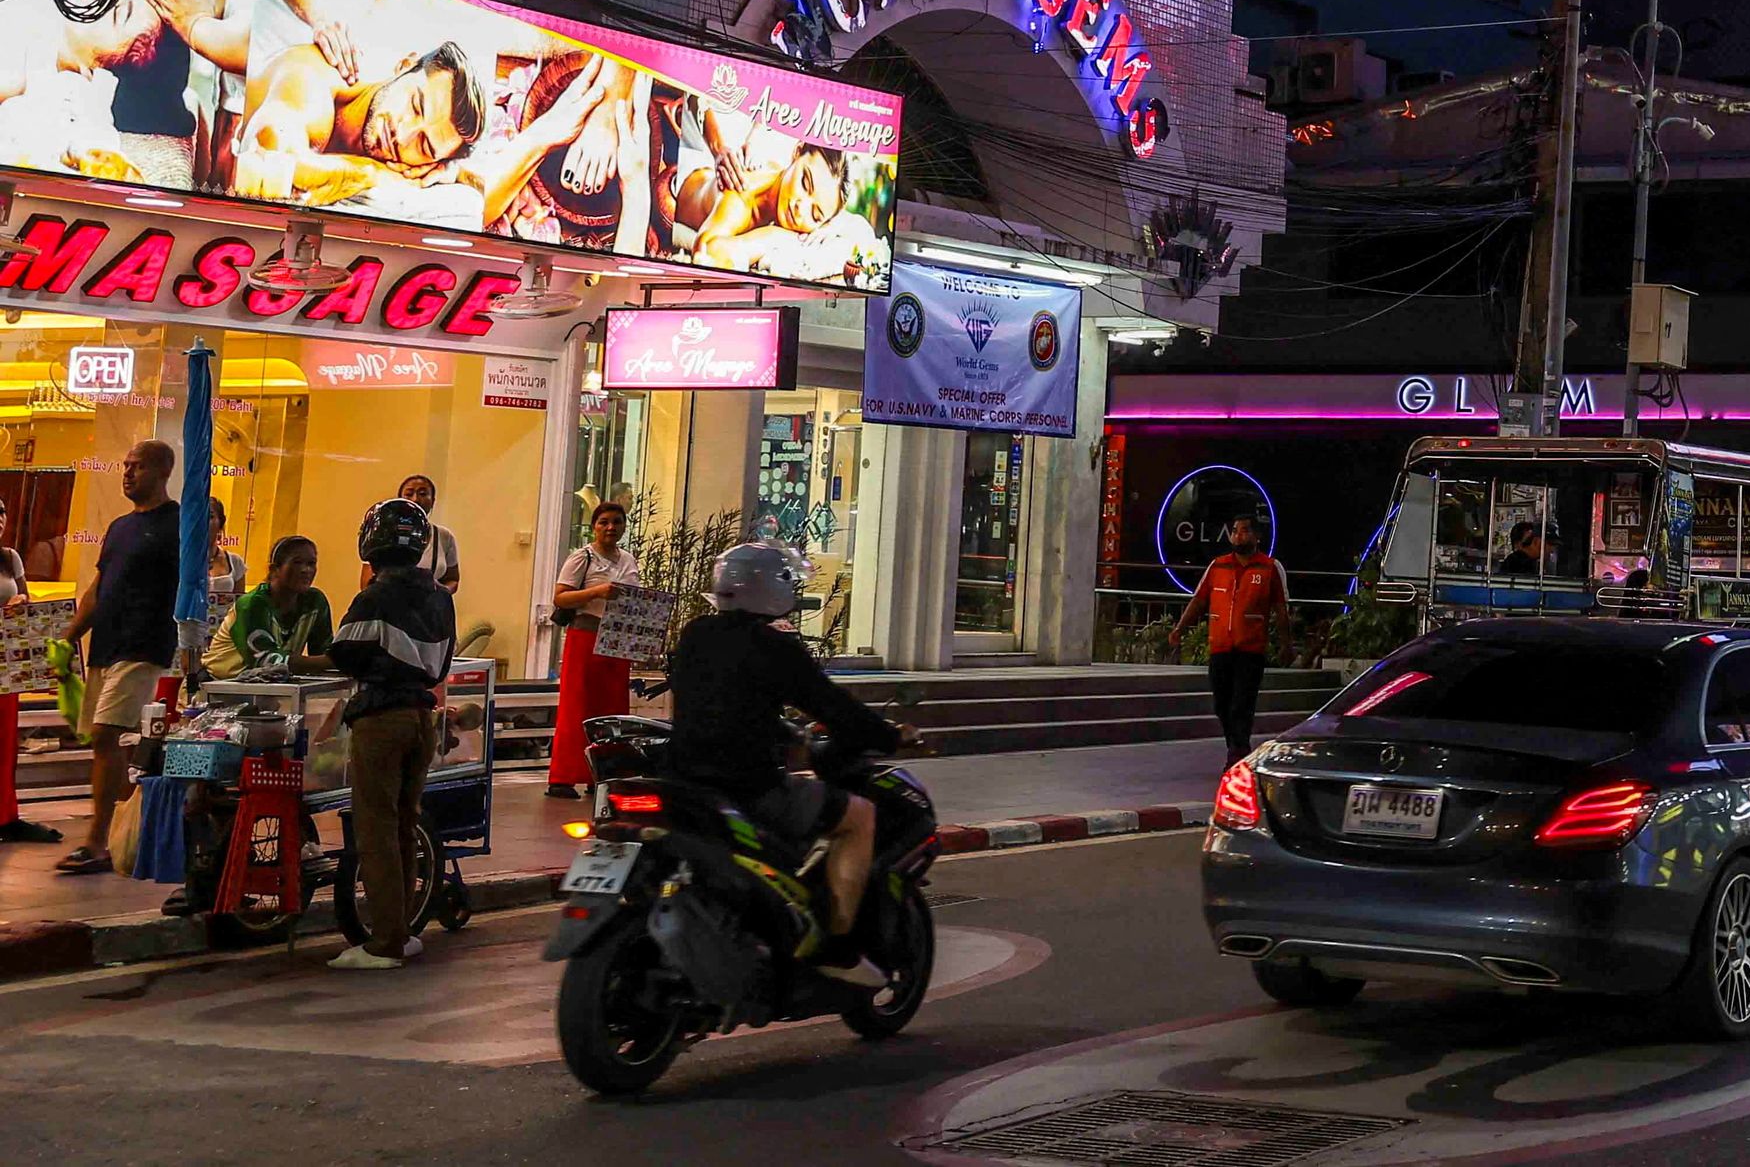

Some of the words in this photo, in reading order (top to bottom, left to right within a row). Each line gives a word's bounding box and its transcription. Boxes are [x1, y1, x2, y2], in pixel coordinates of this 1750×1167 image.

[748, 86, 802, 131] Aree
[804, 99, 896, 156] Massage
[0, 212, 521, 336] MASSAGE
[942, 276, 1002, 297] WELCOME
[75, 356, 129, 384] OPEN
[624, 348, 673, 381] Aree
[679, 348, 757, 382] Massage
[230, 399, 253, 412] Baht
[938, 387, 975, 403] SPECIAL
[979, 391, 1007, 406] OFFER
[1398, 377, 1595, 415] GLM
[866, 399, 883, 413] FOR
[939, 406, 948, 418] &
[951, 407, 985, 422] MARINE
[989, 410, 1022, 425] CORPS
[1024, 412, 1068, 428] PERSONNEL
[222, 466, 245, 477] Baht
[1103, 450, 1119, 587] EXCHANGE
[1176, 521, 1232, 542] GLA
[1250, 574, 1261, 585] 13
[1388, 794, 1436, 817] 4488
